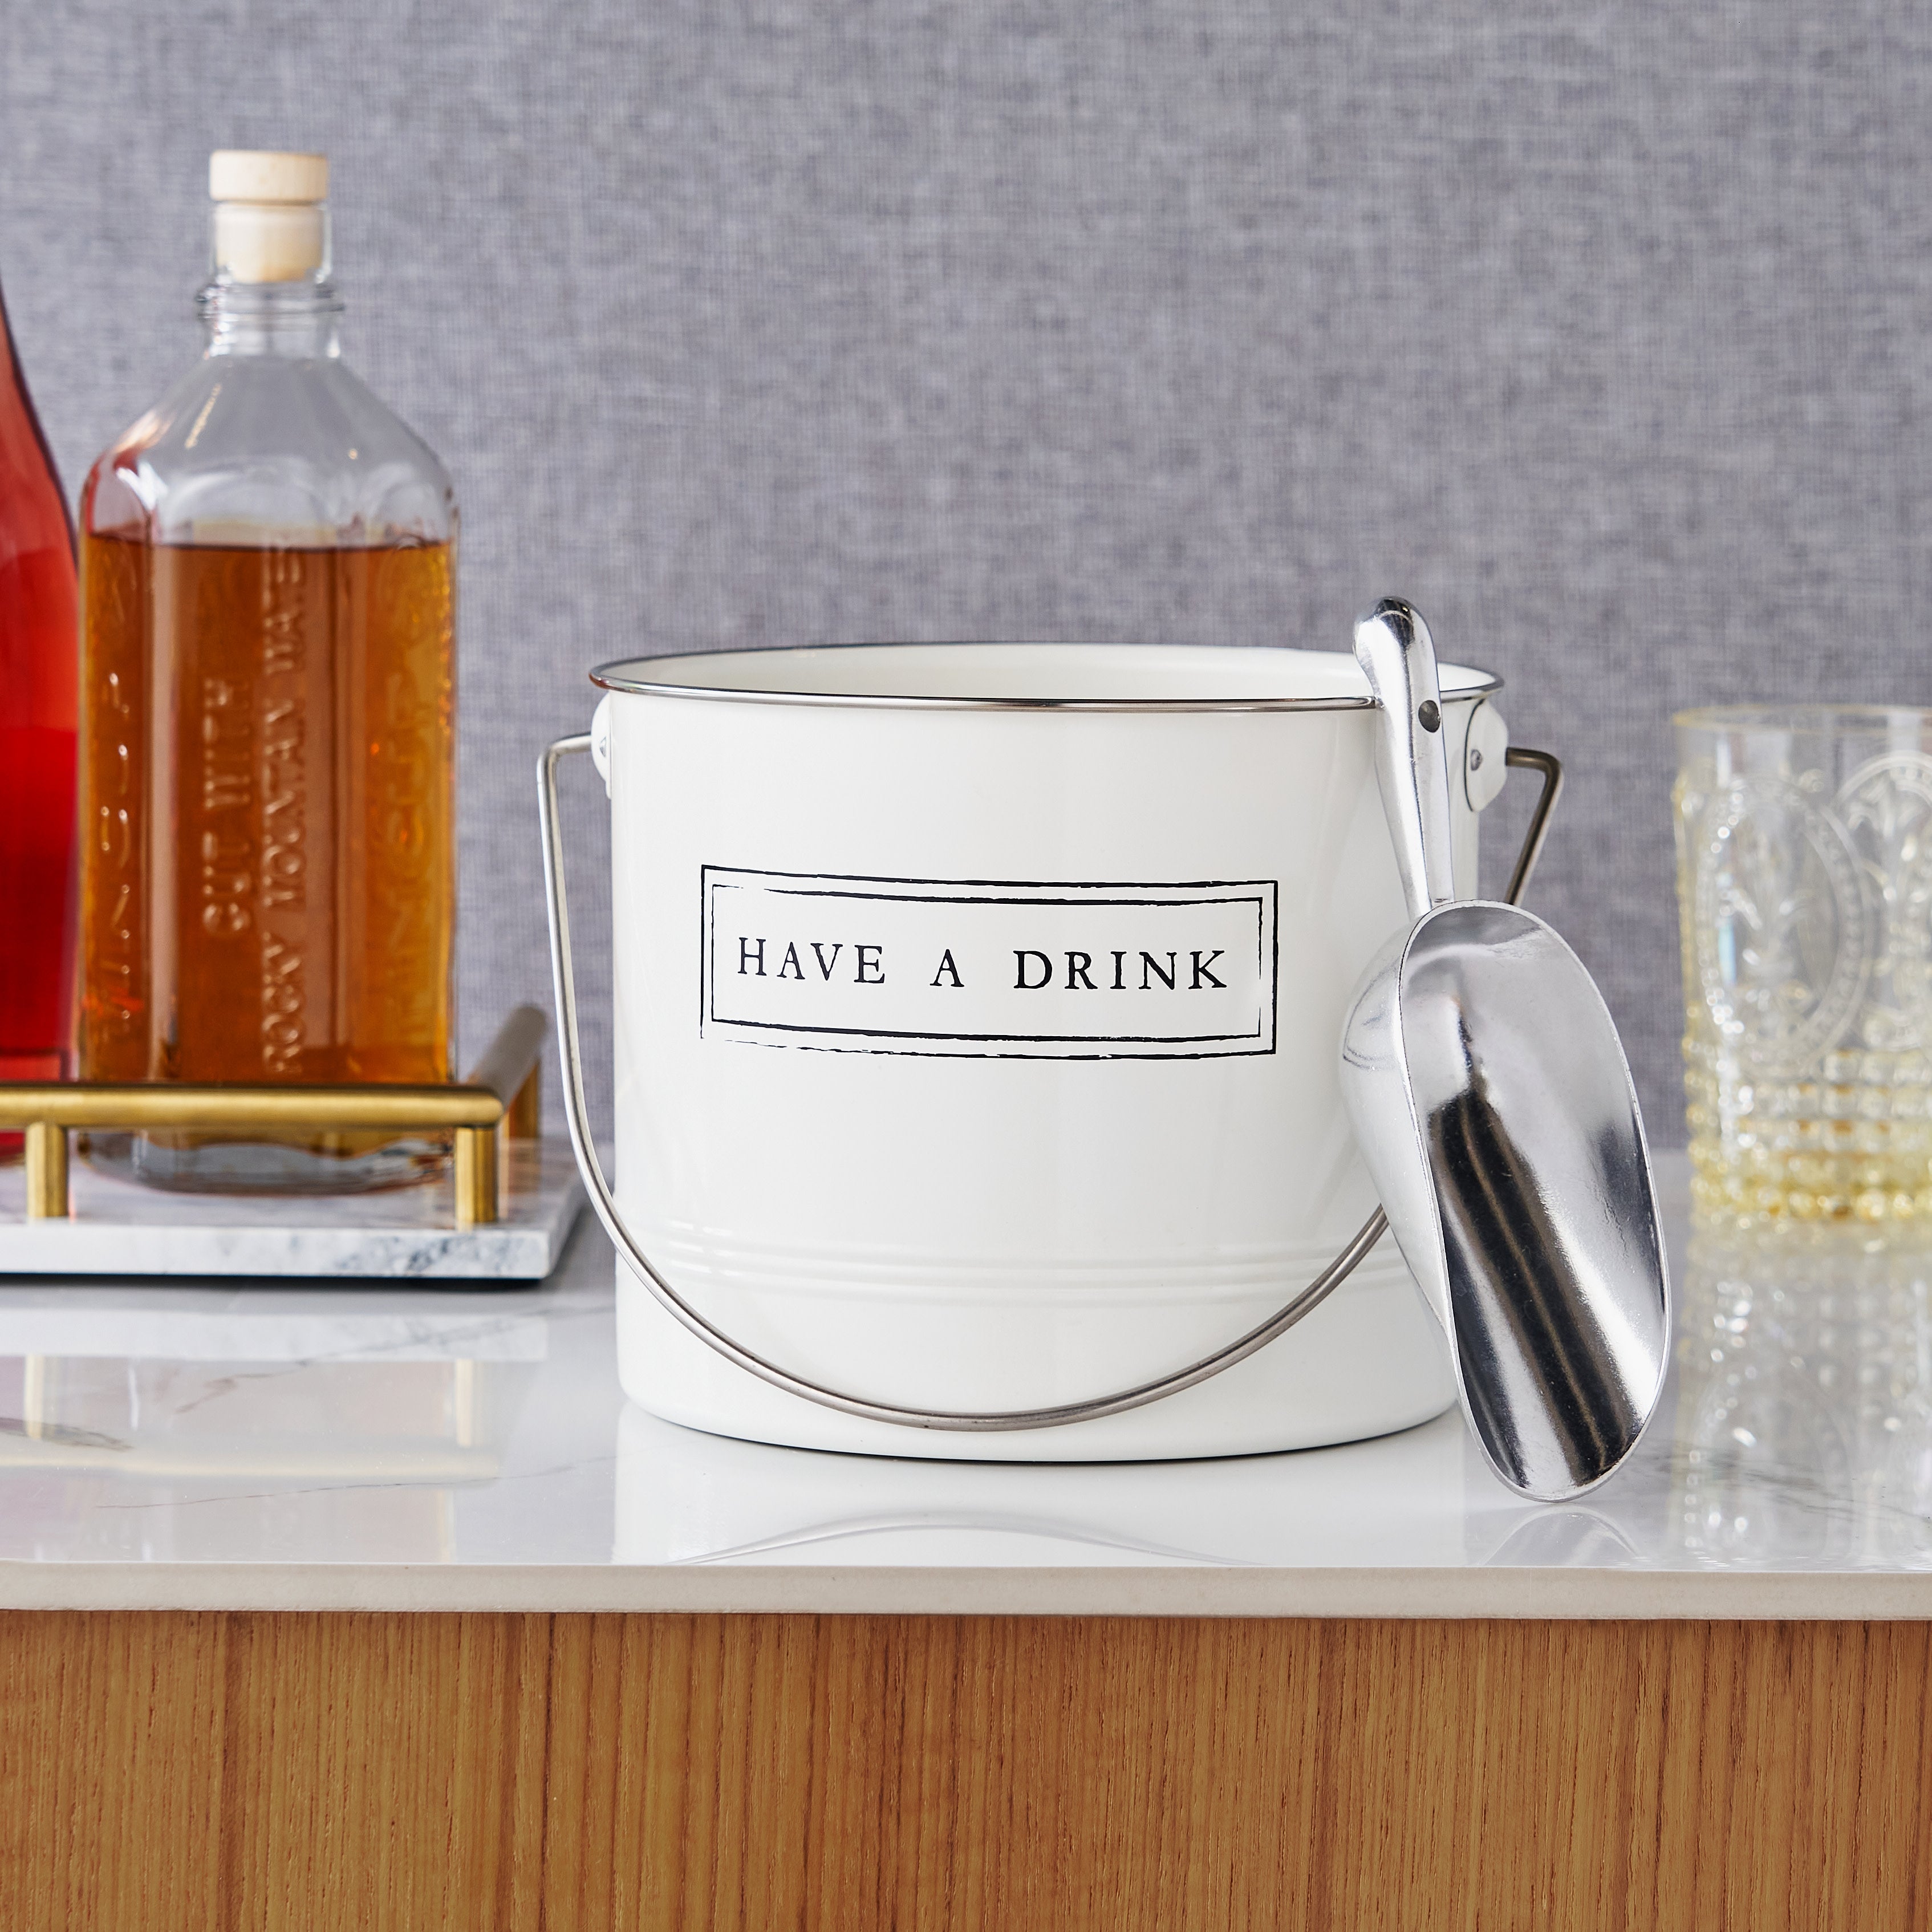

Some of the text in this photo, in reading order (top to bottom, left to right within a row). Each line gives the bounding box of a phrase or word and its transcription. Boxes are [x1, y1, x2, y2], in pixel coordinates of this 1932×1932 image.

[261, 536, 306, 677] WATE
[201, 830, 253, 937] CUT
[737, 937, 1227, 991] HAVE A DRINK
